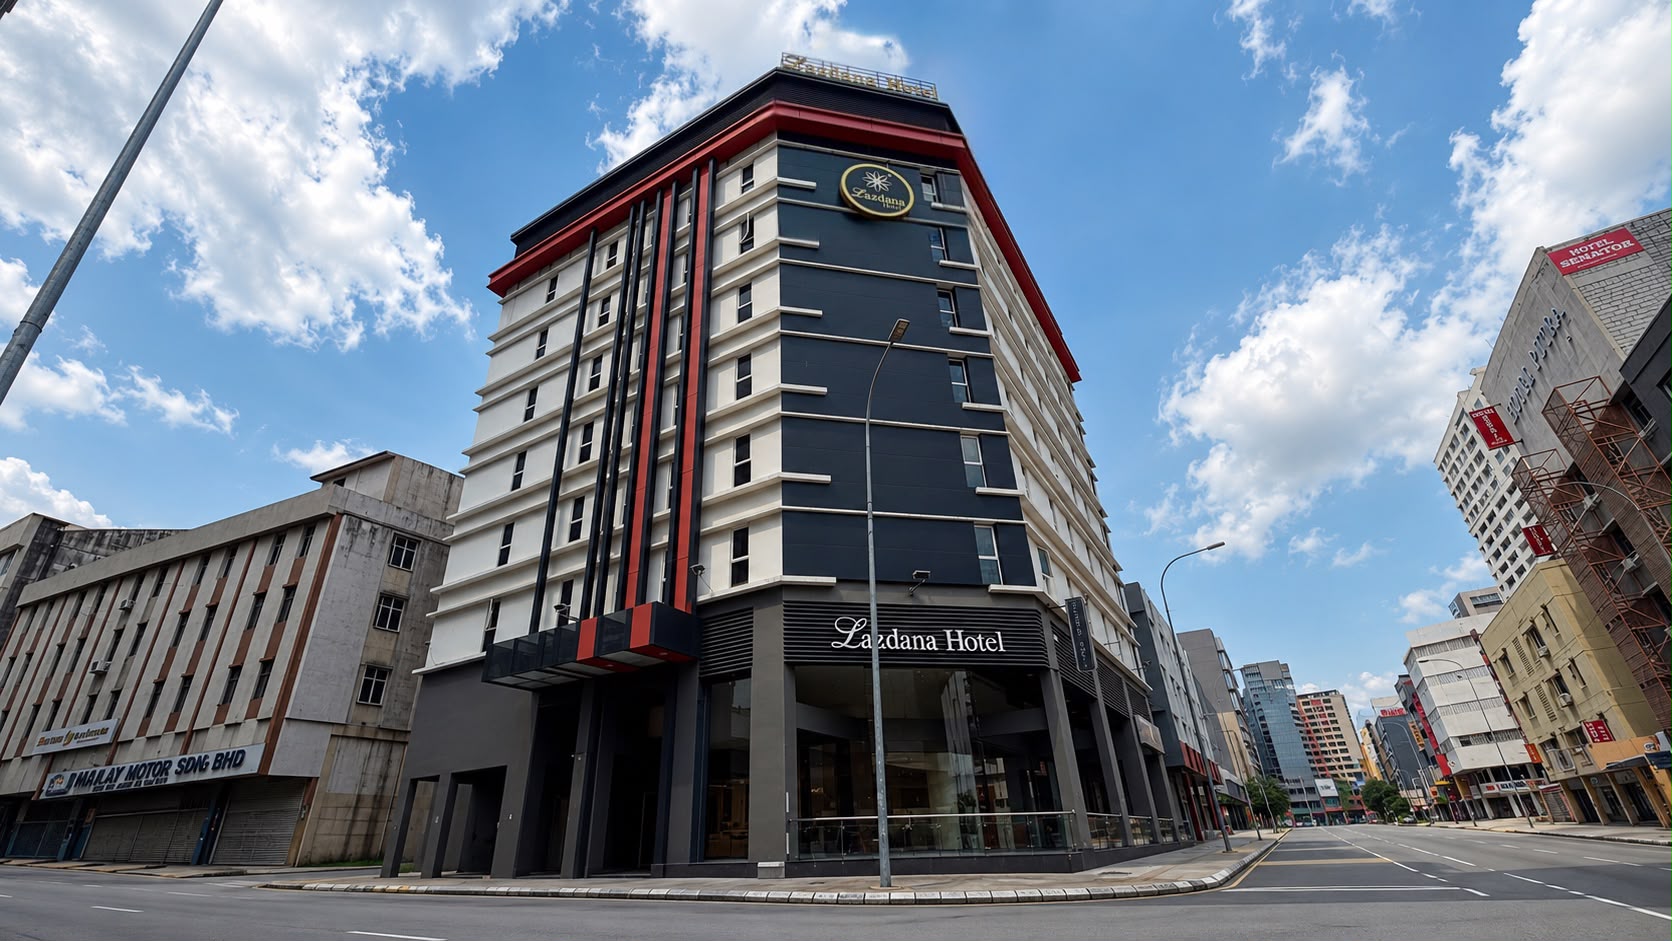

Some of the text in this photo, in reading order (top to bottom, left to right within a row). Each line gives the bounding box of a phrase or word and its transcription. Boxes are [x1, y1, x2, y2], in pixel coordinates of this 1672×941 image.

[885, 76, 937, 99] Hotel
[851, 187, 906, 207] Lazdana
[1569, 239, 1614, 256] HOTEL
[943, 629, 1006, 652] Hotel
[124, 759, 173, 782] MOTOR
[211, 749, 246, 771] BHD
